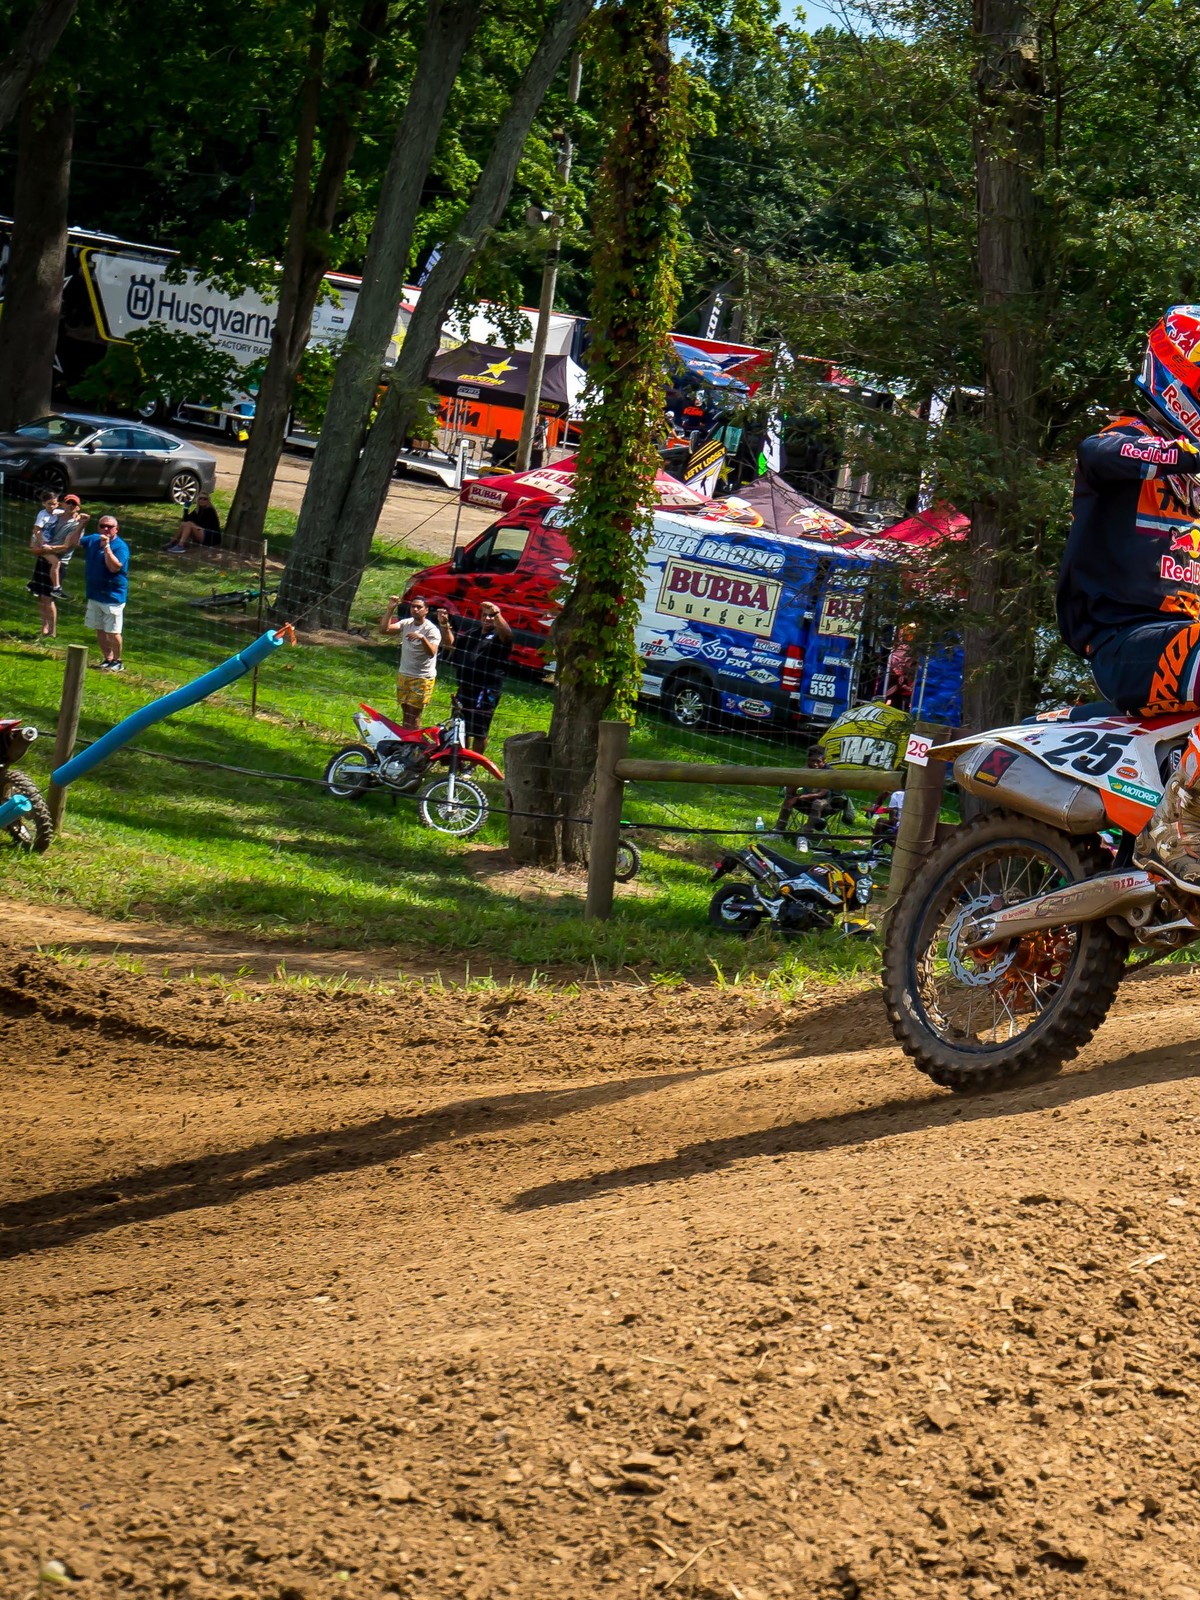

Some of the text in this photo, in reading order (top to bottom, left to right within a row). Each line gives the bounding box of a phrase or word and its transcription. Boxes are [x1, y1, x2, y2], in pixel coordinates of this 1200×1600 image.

[217, 338, 271, 356] FACTORY RAC
[1161, 384, 1198, 426] Red
[1121, 443, 1152, 461] Red
[684, 460, 704, 481] LEFTY
[471, 486, 503, 501] BUBBA
[698, 540, 785, 572] RACING
[1160, 555, 1193, 583] Red
[667, 566, 769, 611] BUBBA
[667, 595, 765, 627] burger
[640, 641, 669, 655] VERTEX
[678, 637, 700, 647] LUCAS
[810, 681, 836, 698] 553
[907, 740, 929, 759] 29
[1042, 731, 1135, 777] 25
[1122, 784, 1160, 803] MOTOREX
